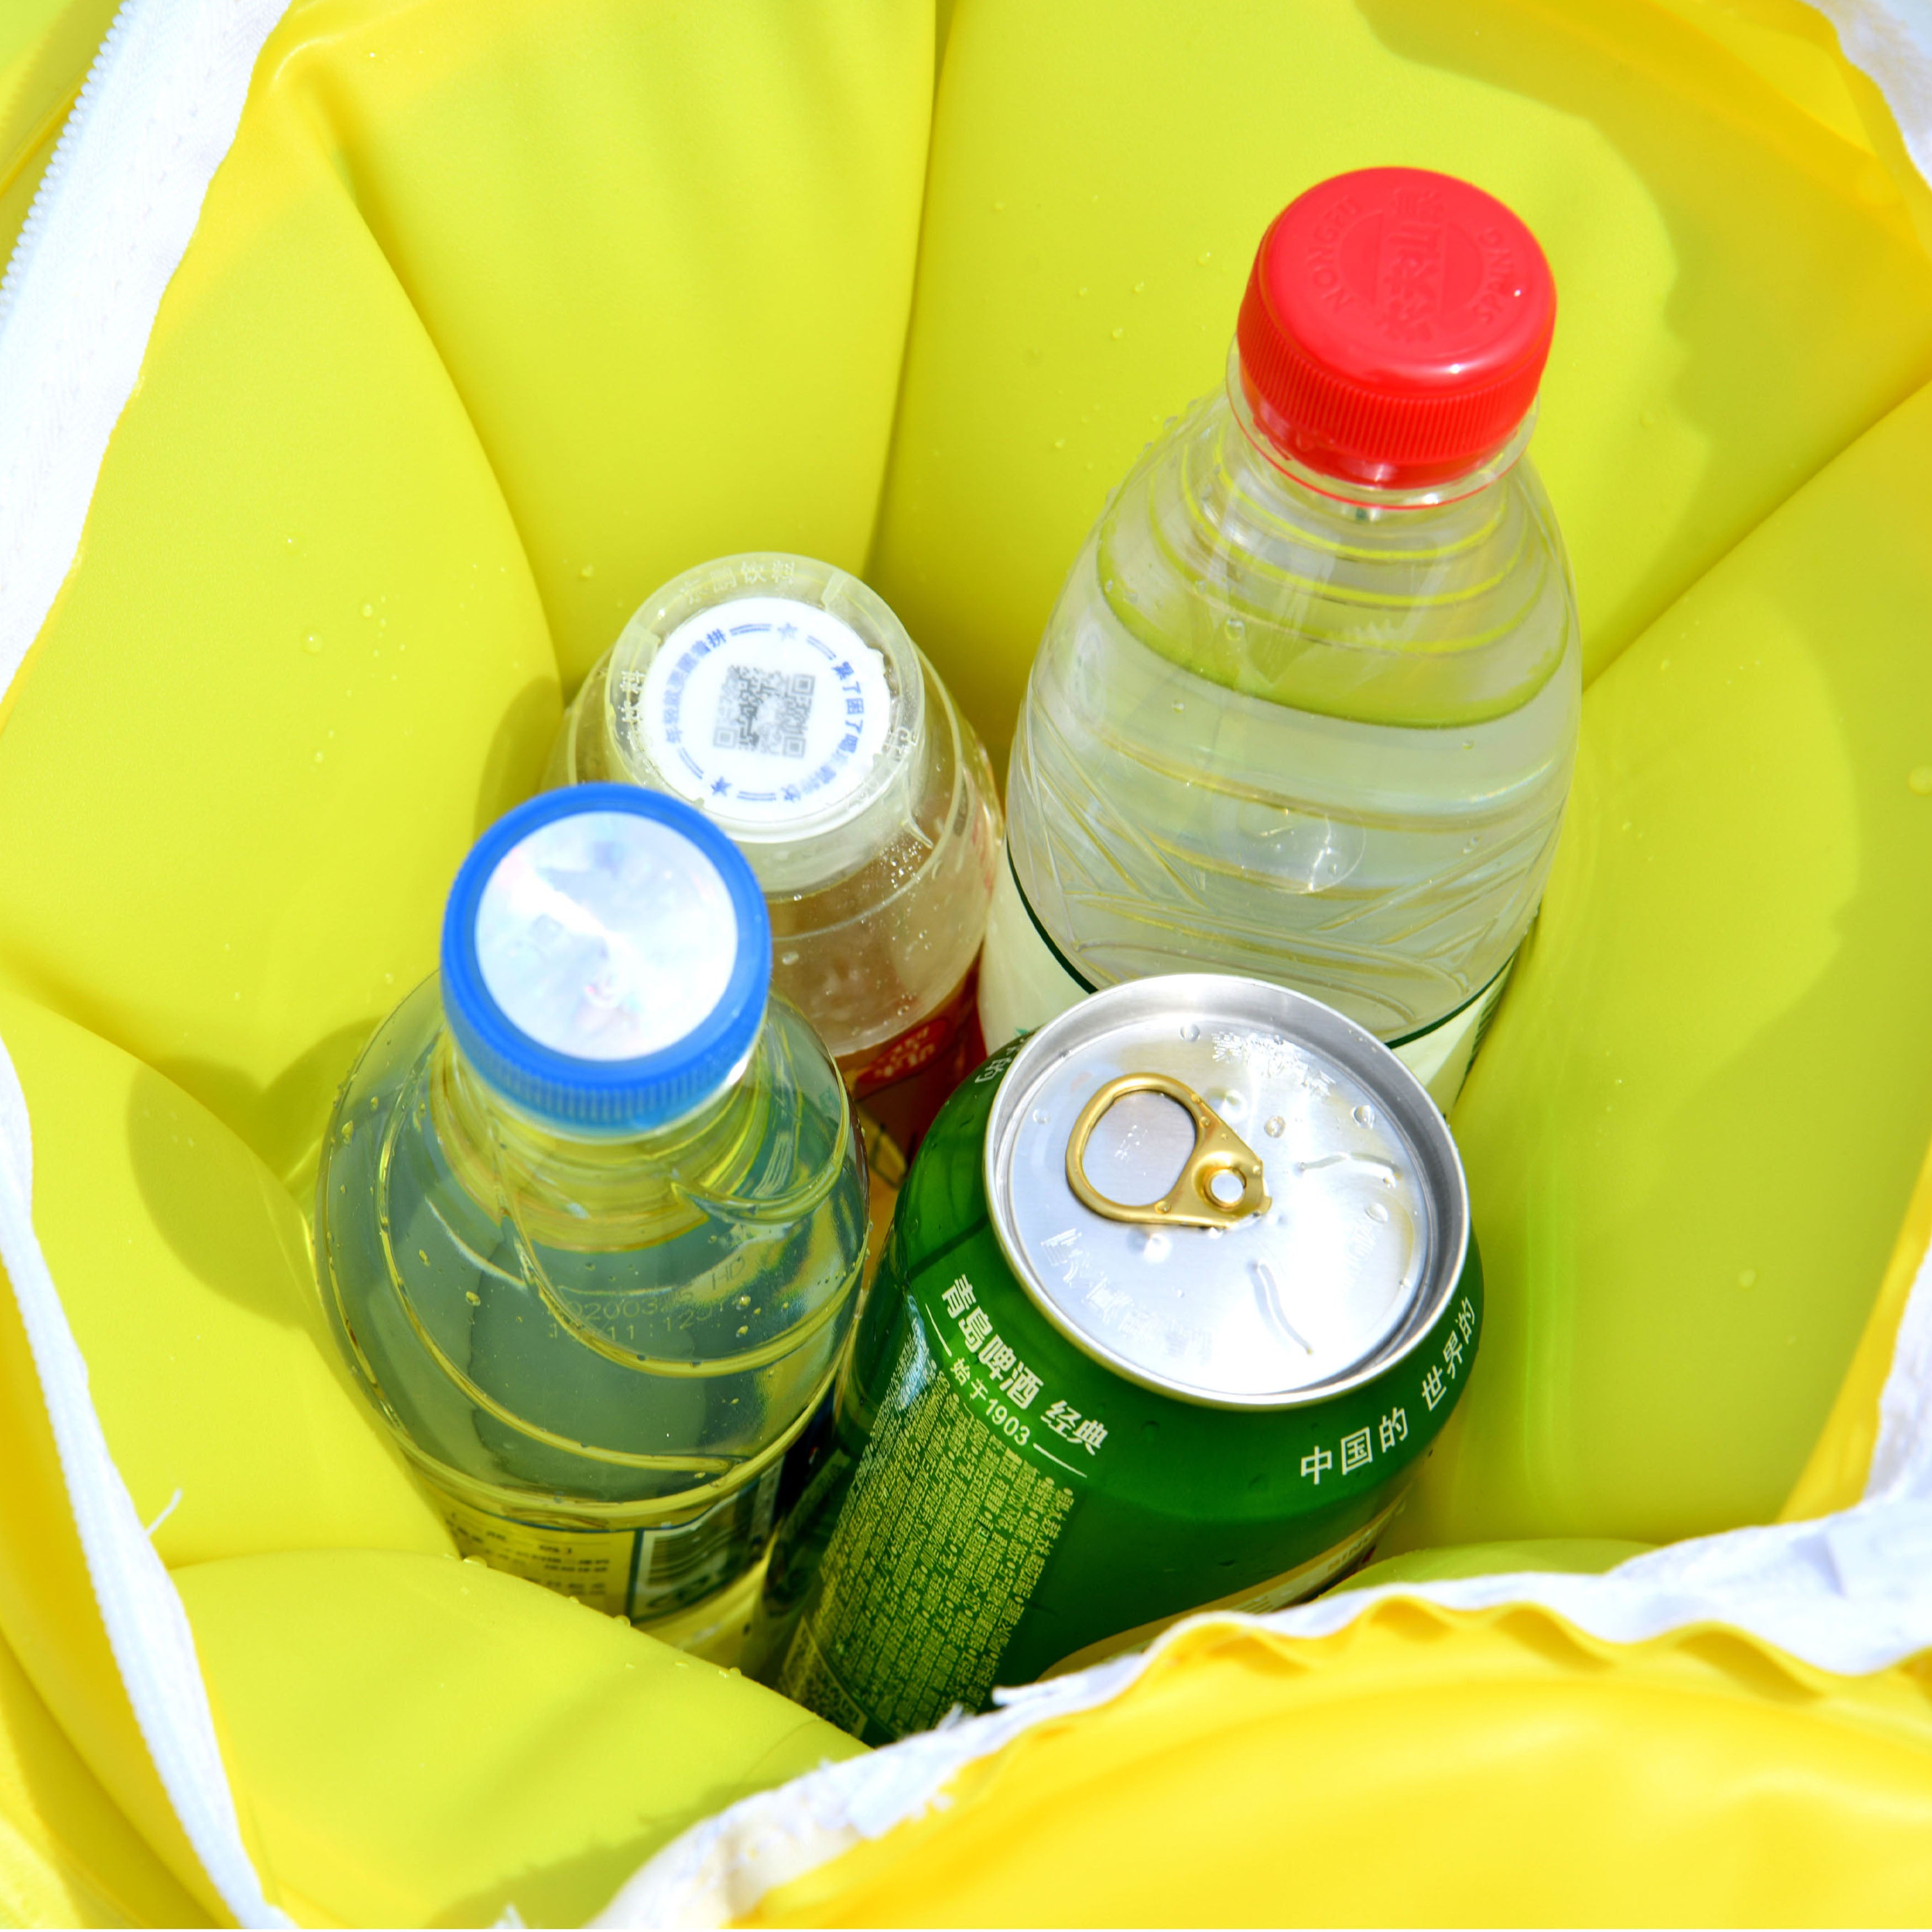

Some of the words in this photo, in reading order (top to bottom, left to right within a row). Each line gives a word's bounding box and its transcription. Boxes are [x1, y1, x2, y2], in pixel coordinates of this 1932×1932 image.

[1304, 195, 1362, 314] NONGFU
[1472, 227, 1516, 325] SPRING
[1041, 1400, 1108, 1456] 经典
[1301, 1407, 1409, 1485] 中国的
[1421, 1296, 1475, 1411] 世界的
